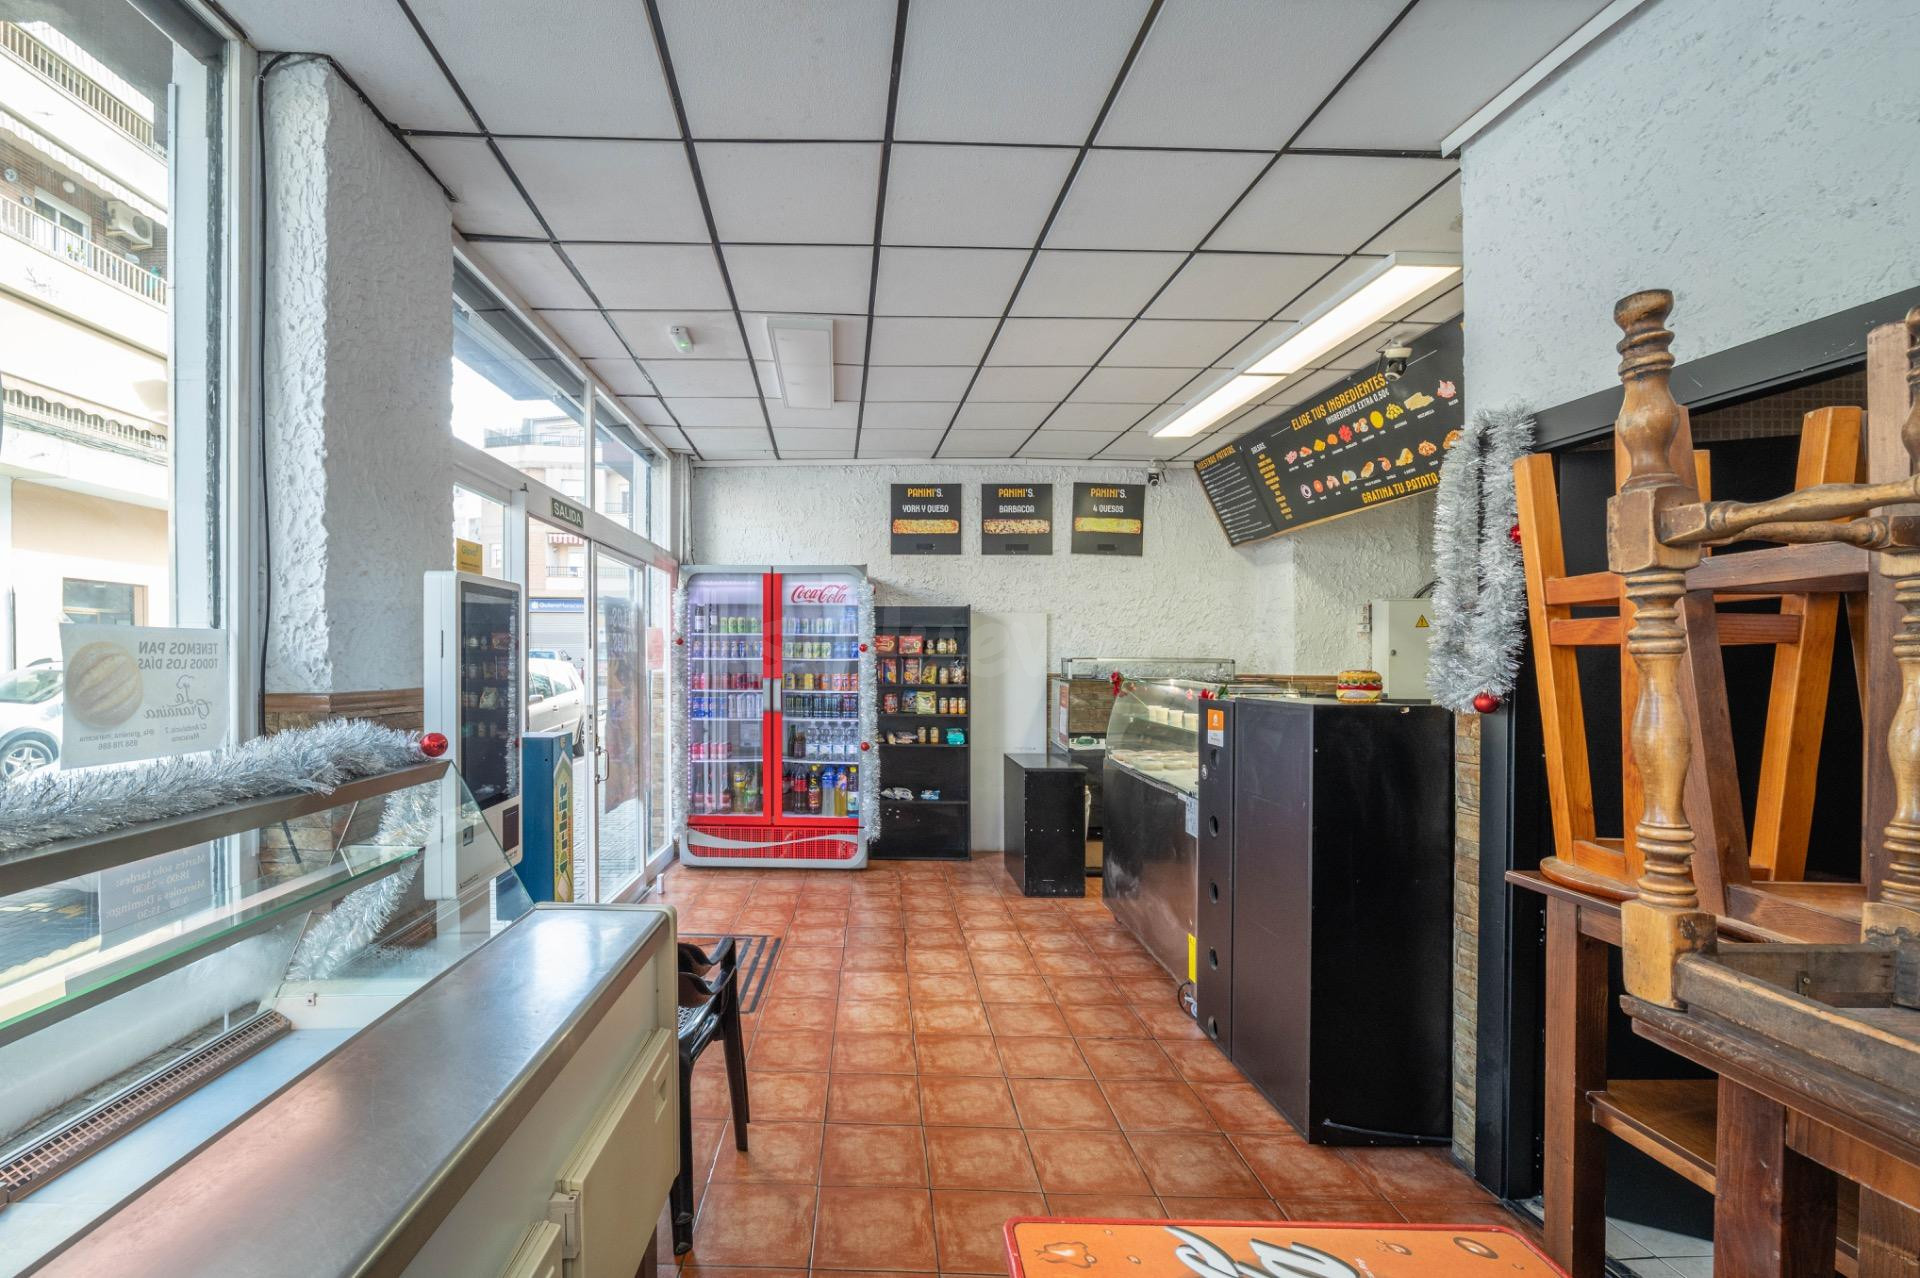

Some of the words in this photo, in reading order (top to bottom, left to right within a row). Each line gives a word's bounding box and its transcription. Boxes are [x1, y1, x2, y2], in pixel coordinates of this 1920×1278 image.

[1291, 411, 1313, 431] ELIGE
[1310, 403, 1327, 421] TUS
[1325, 404, 1358, 425] INGREDIENTE
[1356, 396, 1375, 410] EXTRA
[1361, 486, 1394, 504] GRATINA
[1393, 480, 1405, 495] TU
[1406, 471, 1439, 491] PATATA
[553, 502, 582, 525] SALIDA
[902, 504, 920, 513] YORK
[921, 504, 926, 513] Y
[927, 504, 949, 513] QUESO
[999, 504, 1035, 513] BARBACOA
[1092, 504, 1098, 513] 4
[1098, 503, 1124, 513] QUESOS
